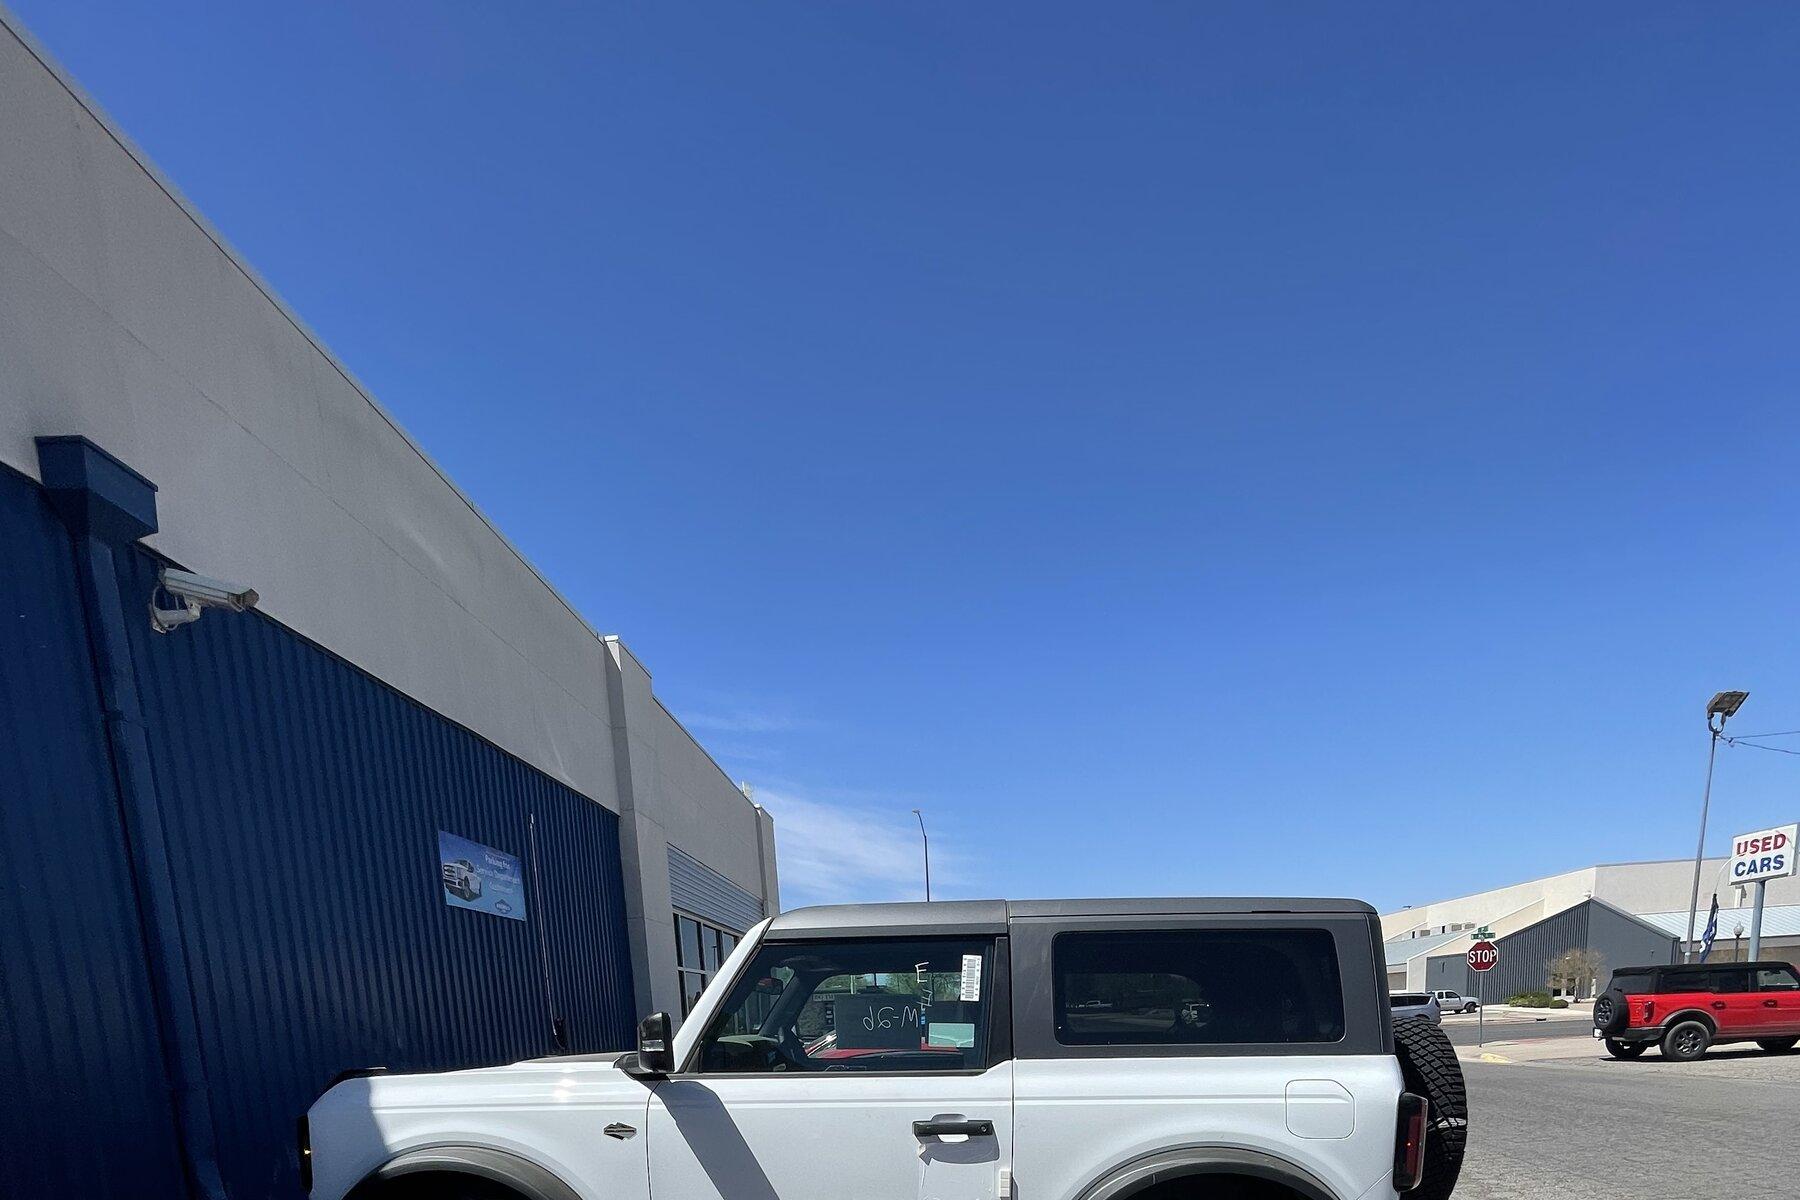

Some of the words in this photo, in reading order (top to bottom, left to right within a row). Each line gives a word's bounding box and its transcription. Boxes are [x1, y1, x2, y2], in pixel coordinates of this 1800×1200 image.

[1736, 833, 1787, 857] USED
[1734, 854, 1785, 877] CARS
[1469, 950, 1497, 964] STOP
